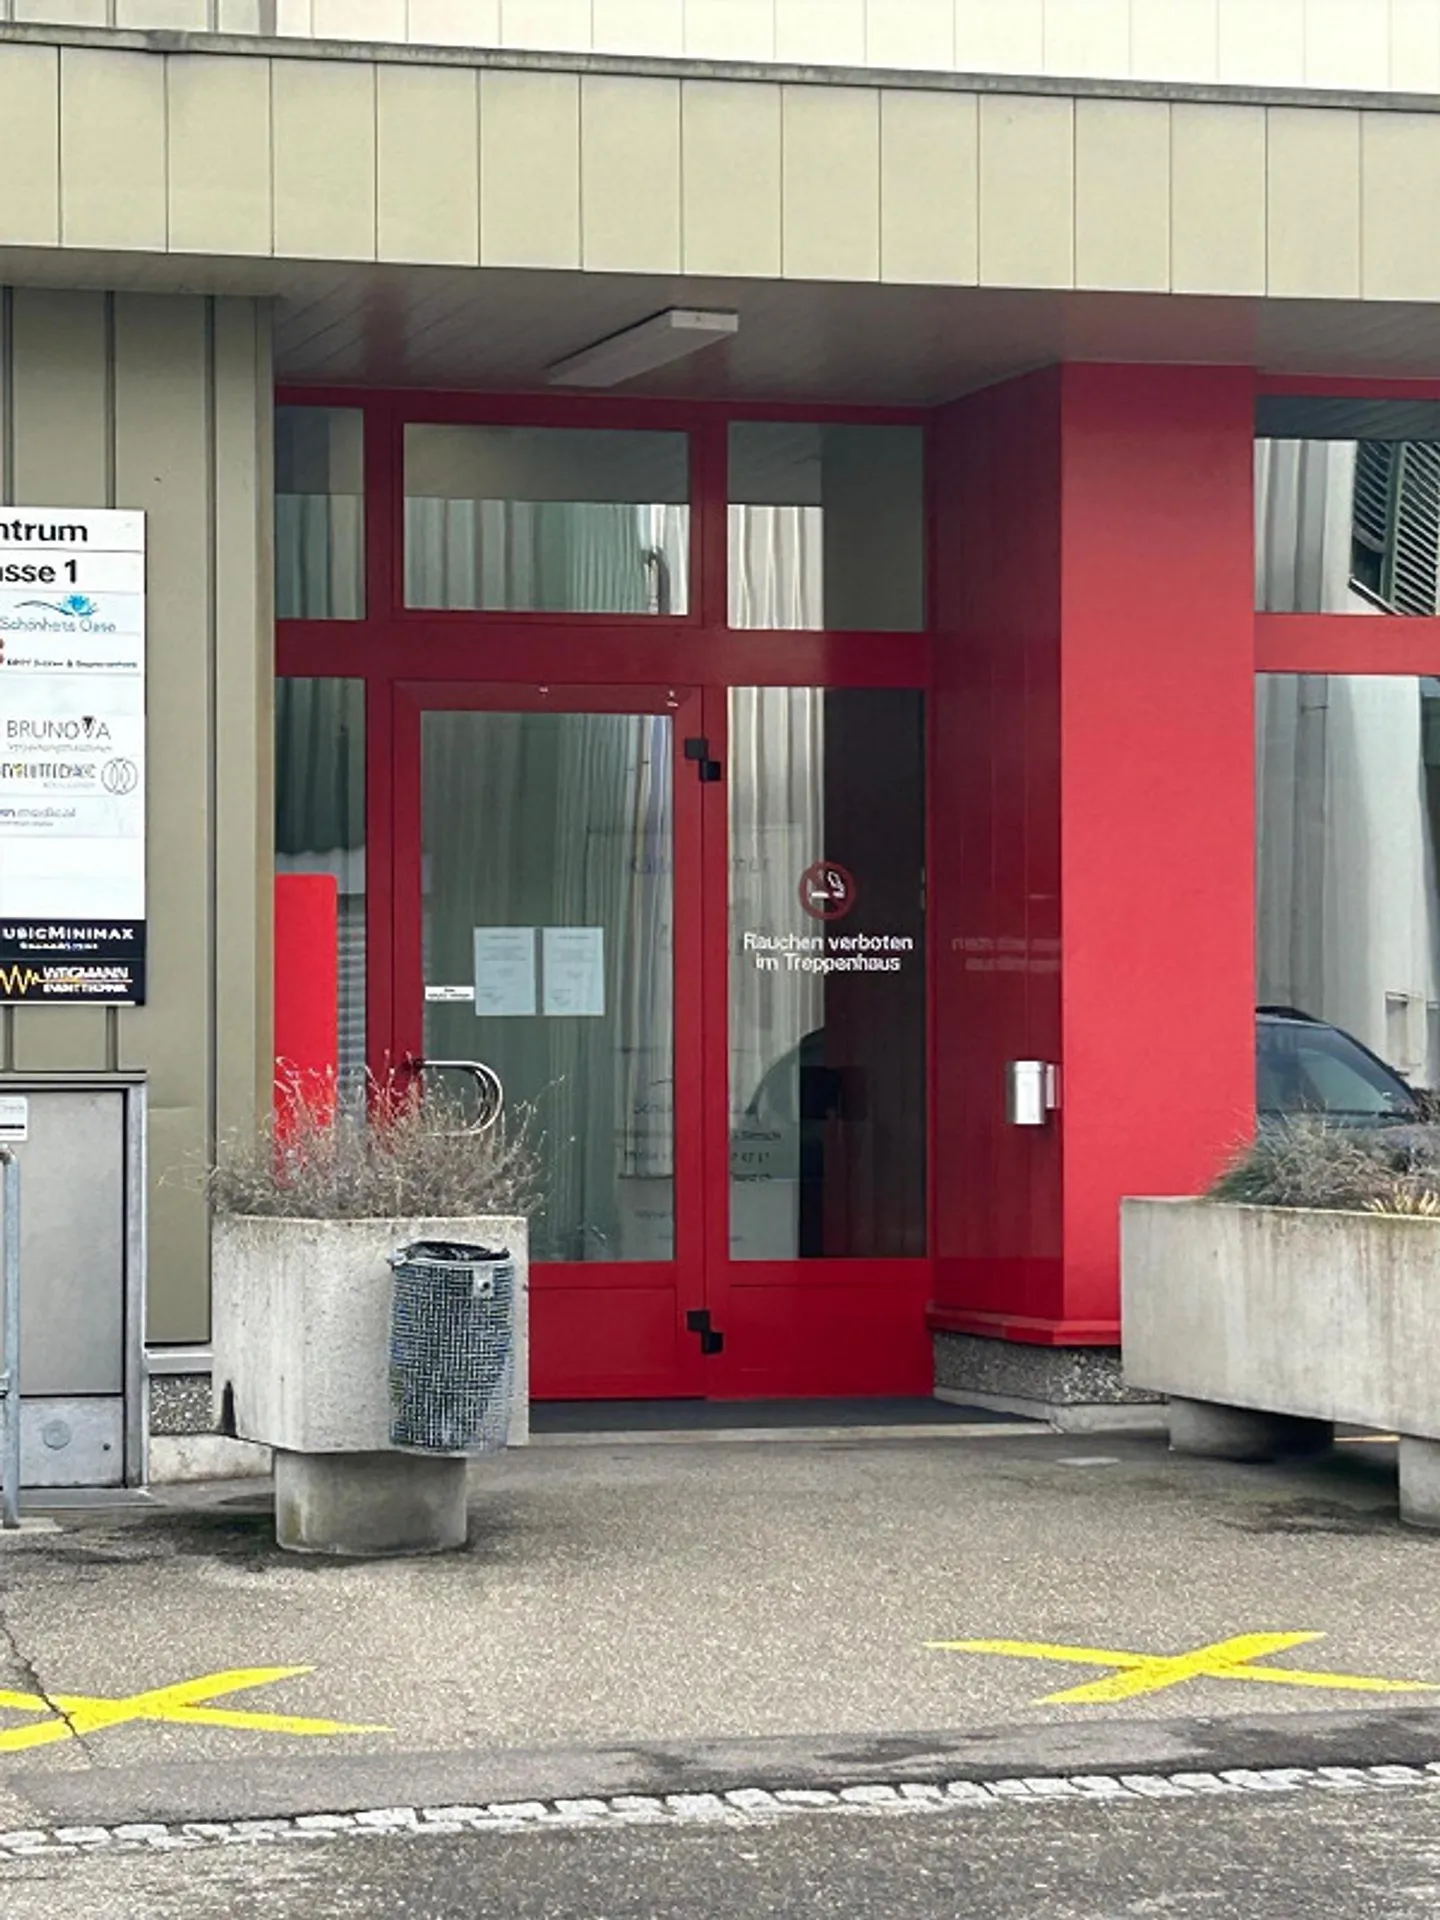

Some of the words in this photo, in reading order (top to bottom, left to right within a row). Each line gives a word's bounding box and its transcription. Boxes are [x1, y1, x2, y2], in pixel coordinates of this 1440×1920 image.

[0, 563, 56, 584] sse
[64, 559, 77, 584] 1
[7, 715, 112, 741] BRUNOVA
[743, 932, 824, 951] Rauchen
[828, 933, 914, 951] verboten
[755, 953, 779, 971] im
[783, 953, 901, 975] Treppenhaus
